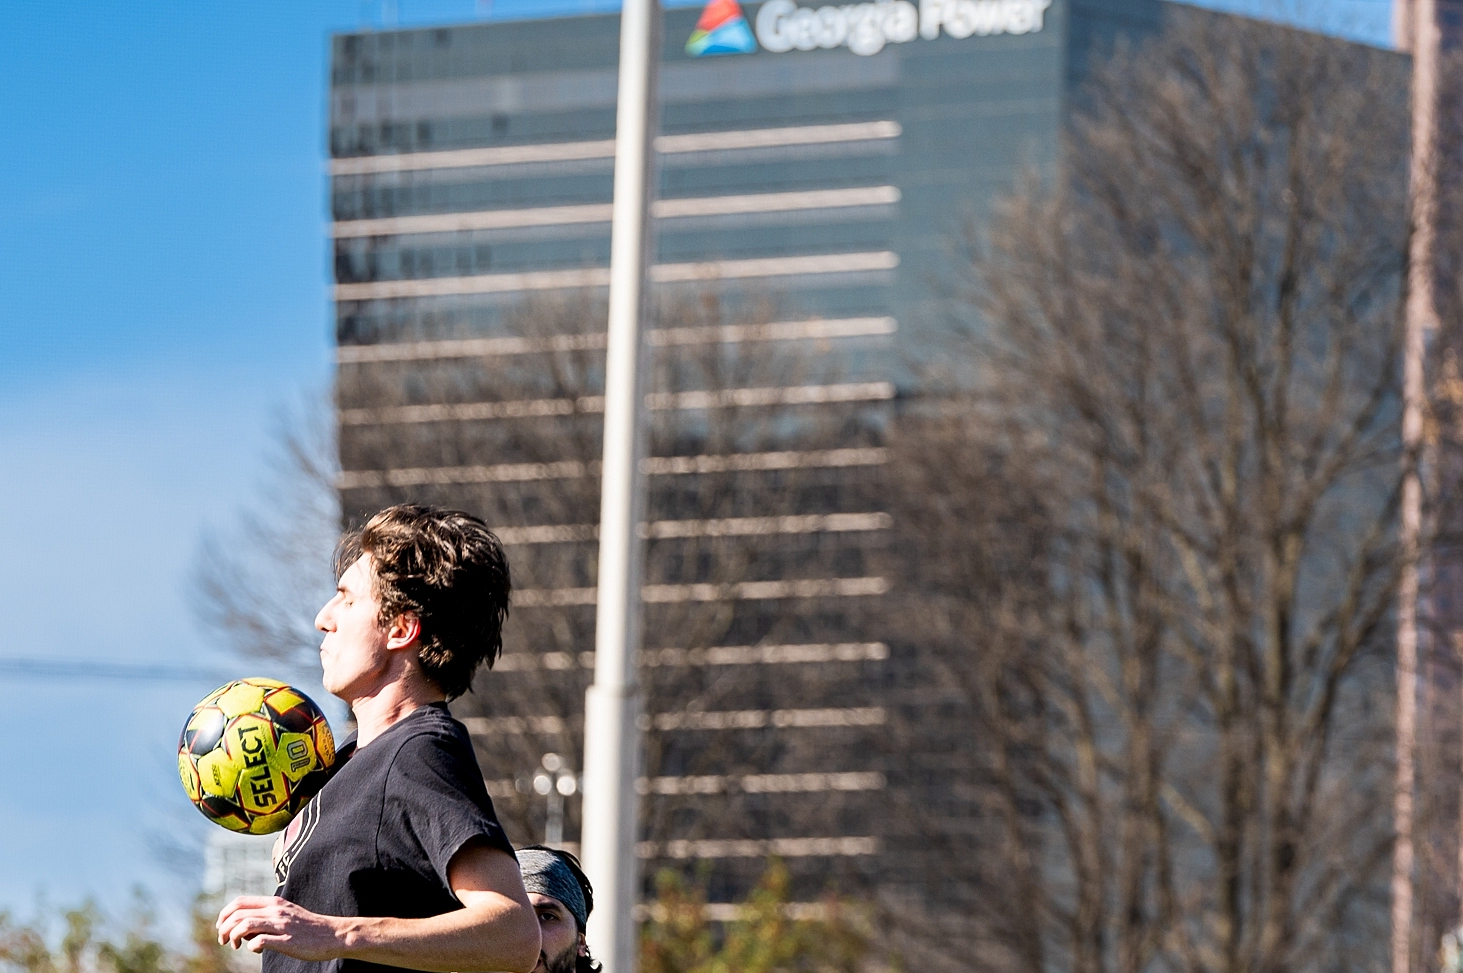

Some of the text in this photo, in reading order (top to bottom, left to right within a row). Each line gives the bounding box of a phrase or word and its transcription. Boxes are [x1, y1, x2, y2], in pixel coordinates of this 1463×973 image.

[755, 0, 1054, 56] Georgia Power
[238, 726, 277, 808] SELECT
